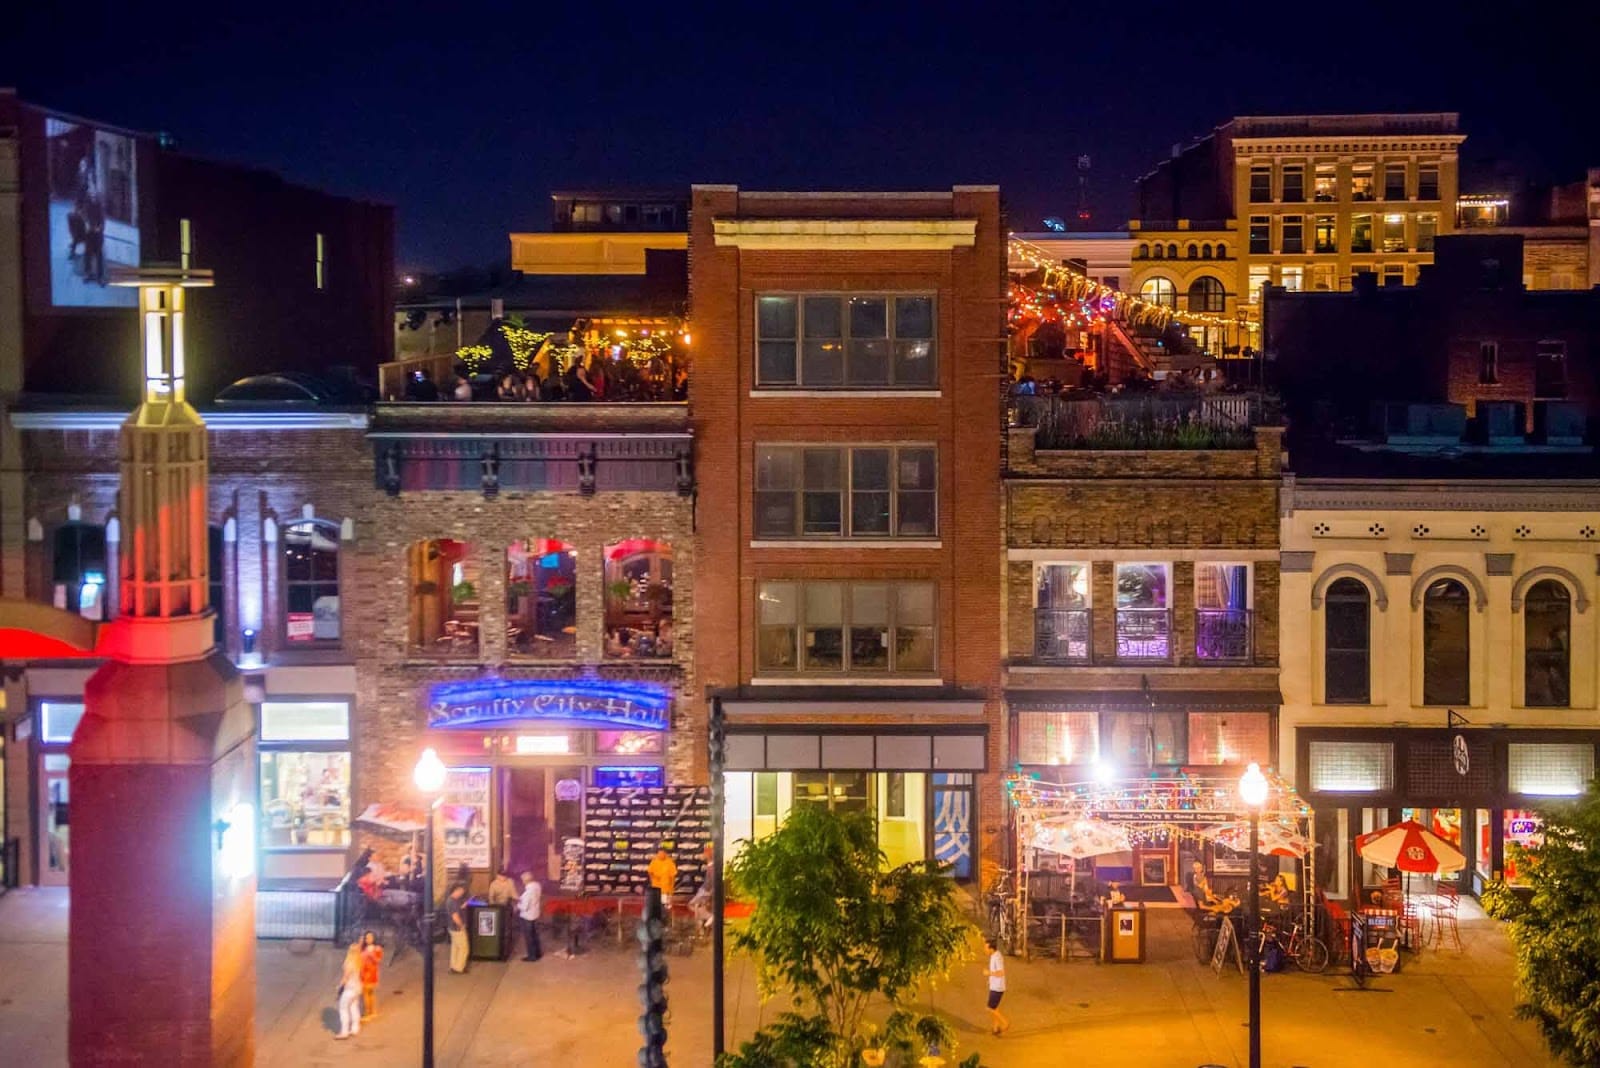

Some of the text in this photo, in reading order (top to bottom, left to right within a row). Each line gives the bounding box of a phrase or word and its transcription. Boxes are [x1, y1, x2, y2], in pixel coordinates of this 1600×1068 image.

[430, 694, 665, 723] Scruffy City Hall
